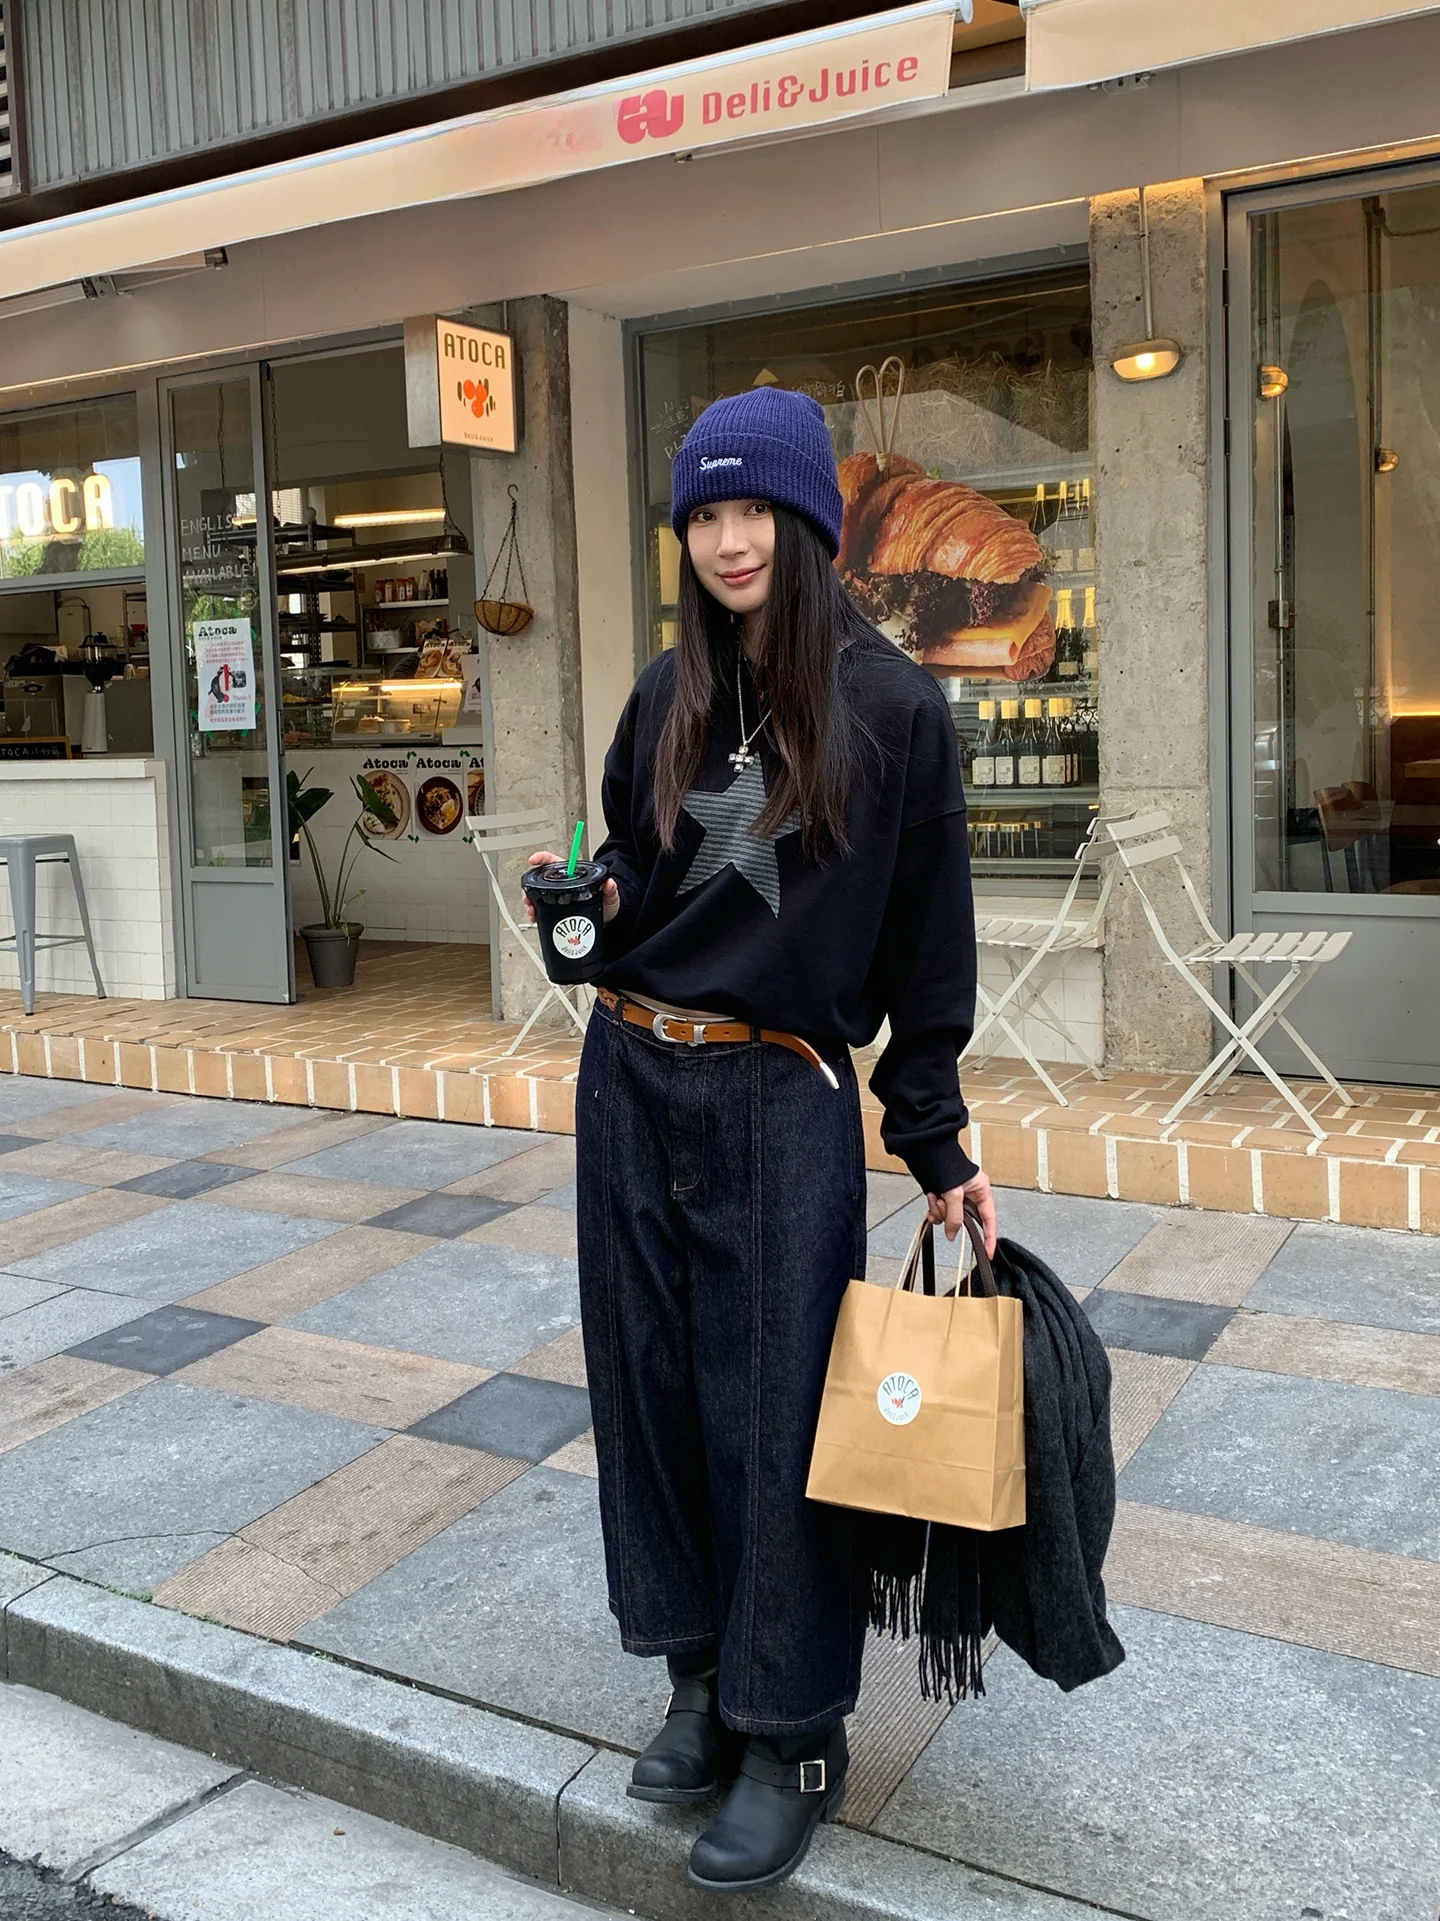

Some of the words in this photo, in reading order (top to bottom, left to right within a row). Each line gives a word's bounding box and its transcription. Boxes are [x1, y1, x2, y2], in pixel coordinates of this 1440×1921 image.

[702, 56, 919, 124] Deli&Juice
[444, 332, 506, 369] ATOCA
[699, 456, 743, 471] Supreme
[182, 544, 221, 562] MENU
[198, 626, 237, 637] Atoca
[363, 758, 409, 769] Atoca
[416, 758, 462, 769] Atoca
[555, 918, 592, 938] ATOCA
[882, 1375, 919, 1400] ATOCA
